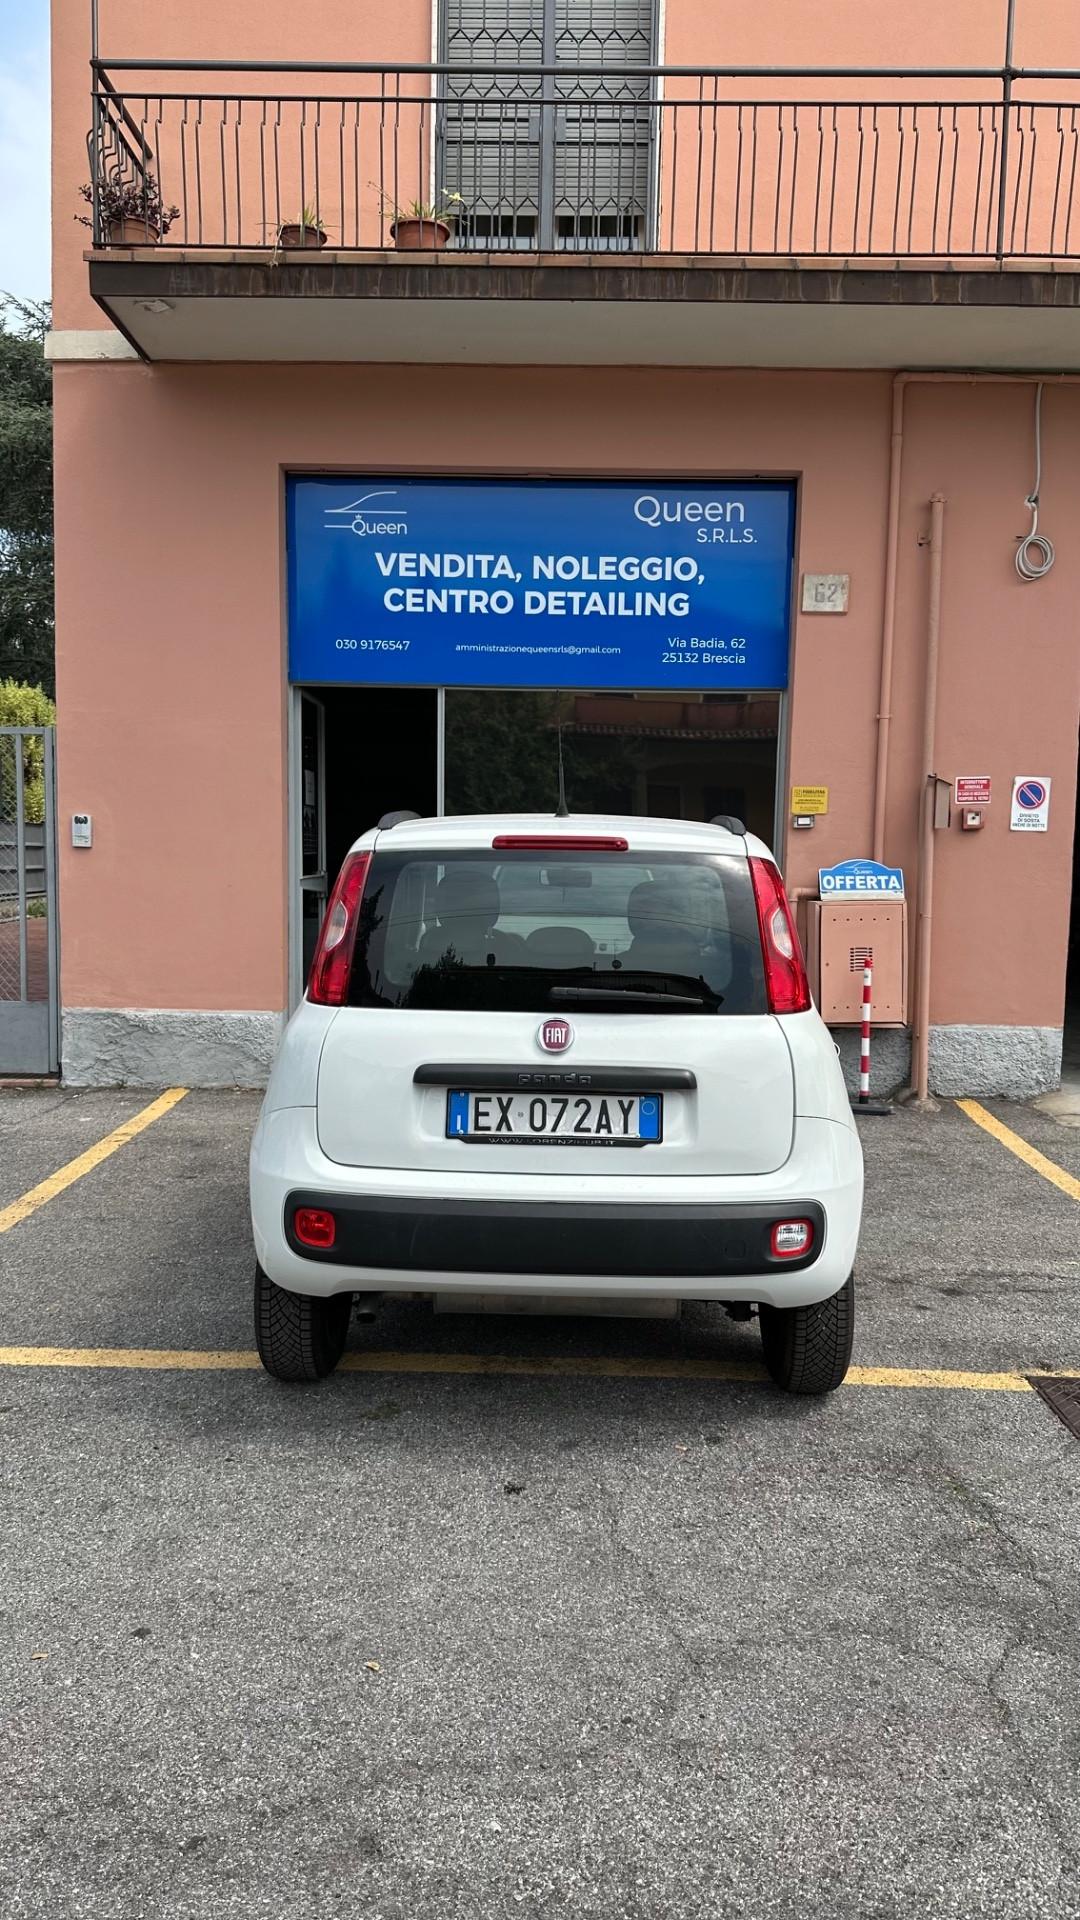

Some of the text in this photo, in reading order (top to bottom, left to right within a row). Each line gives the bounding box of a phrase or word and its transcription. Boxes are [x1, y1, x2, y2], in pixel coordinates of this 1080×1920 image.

[634, 496, 745, 527] Queen
[352, 518, 408, 536] Queen
[696, 528, 758, 543] S.R.L.S.
[375, 552, 705, 585] VENDITA, NOLEGGIO,
[383, 588, 690, 616] CENTRO DETAILING
[335, 639, 410, 651] 030 9176547
[455, 643, 621, 656] amministrazionequeensrls@gmail.com
[668, 638, 746, 650] Via Badia, 62
[662, 653, 746, 664] 25132 Brescia
[822, 875, 901, 889] OFFERTA
[546, 1027, 567, 1043] FIAT
[474, 1096, 635, 1134] EX 072AY
